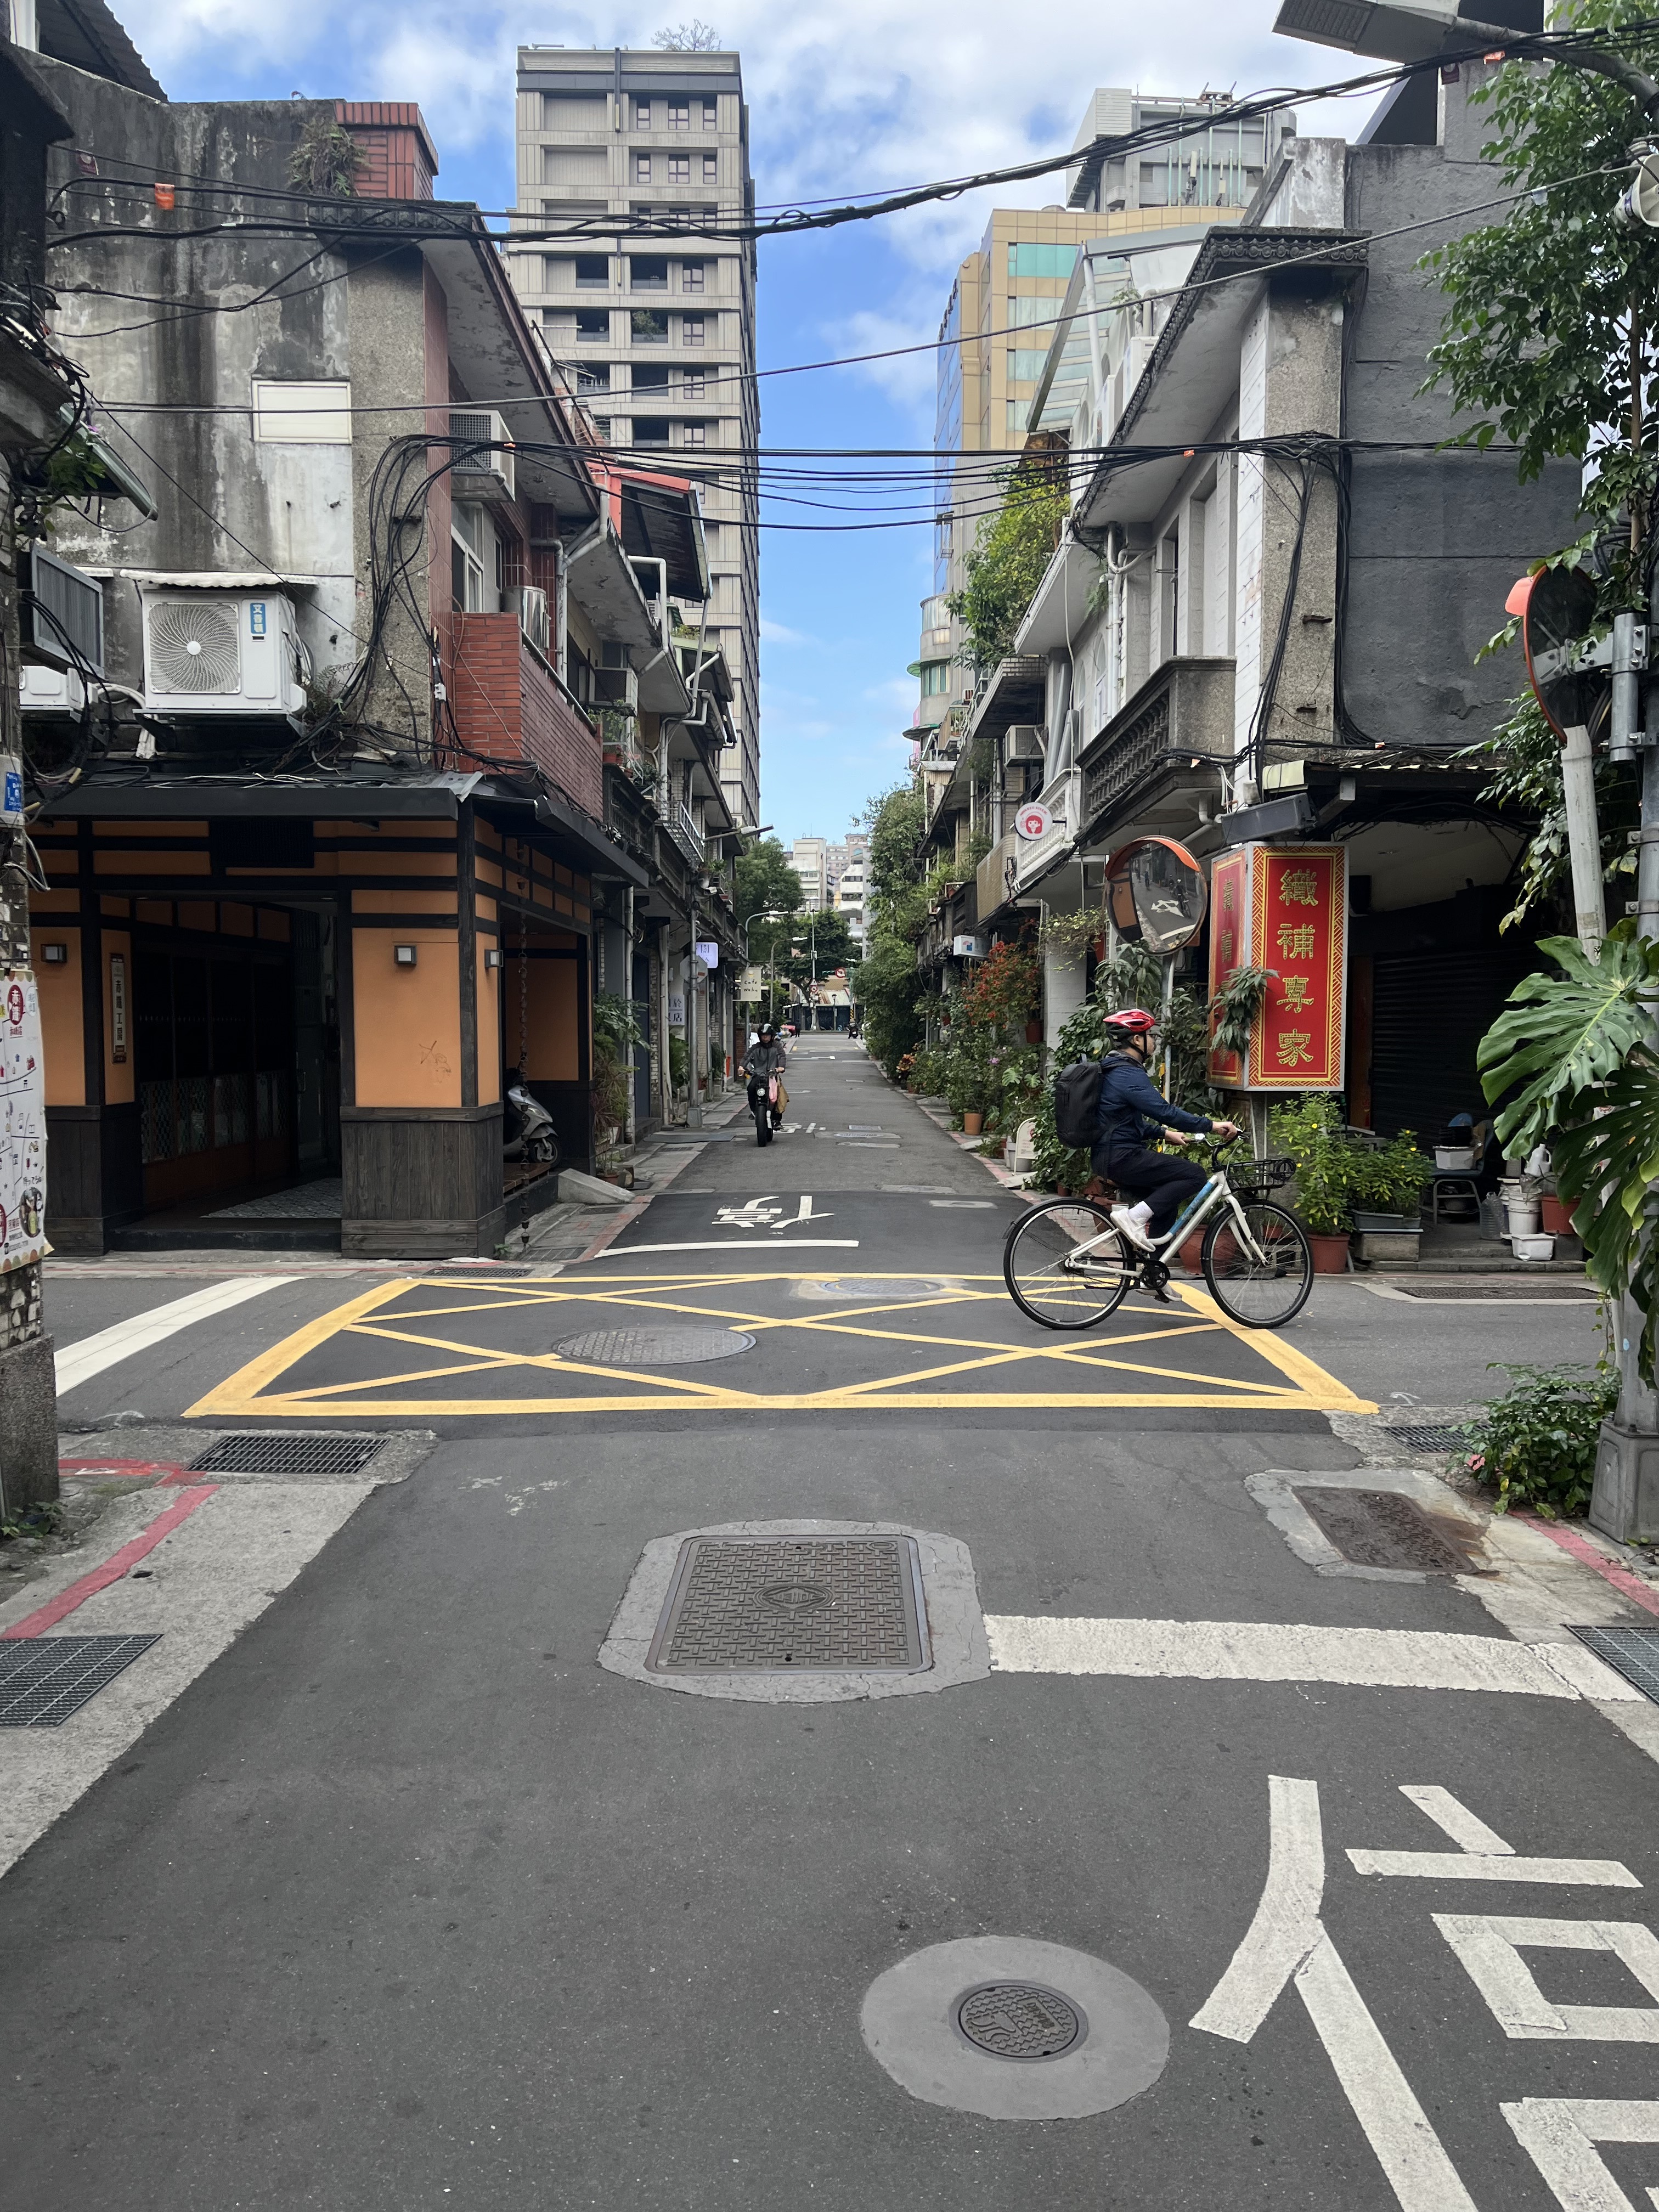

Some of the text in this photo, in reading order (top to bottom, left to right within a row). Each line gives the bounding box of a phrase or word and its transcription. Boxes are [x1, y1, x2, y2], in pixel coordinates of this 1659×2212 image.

[1276, 868, 1319, 1066] 織補專家
[711, 1195, 836, 1228] 停
